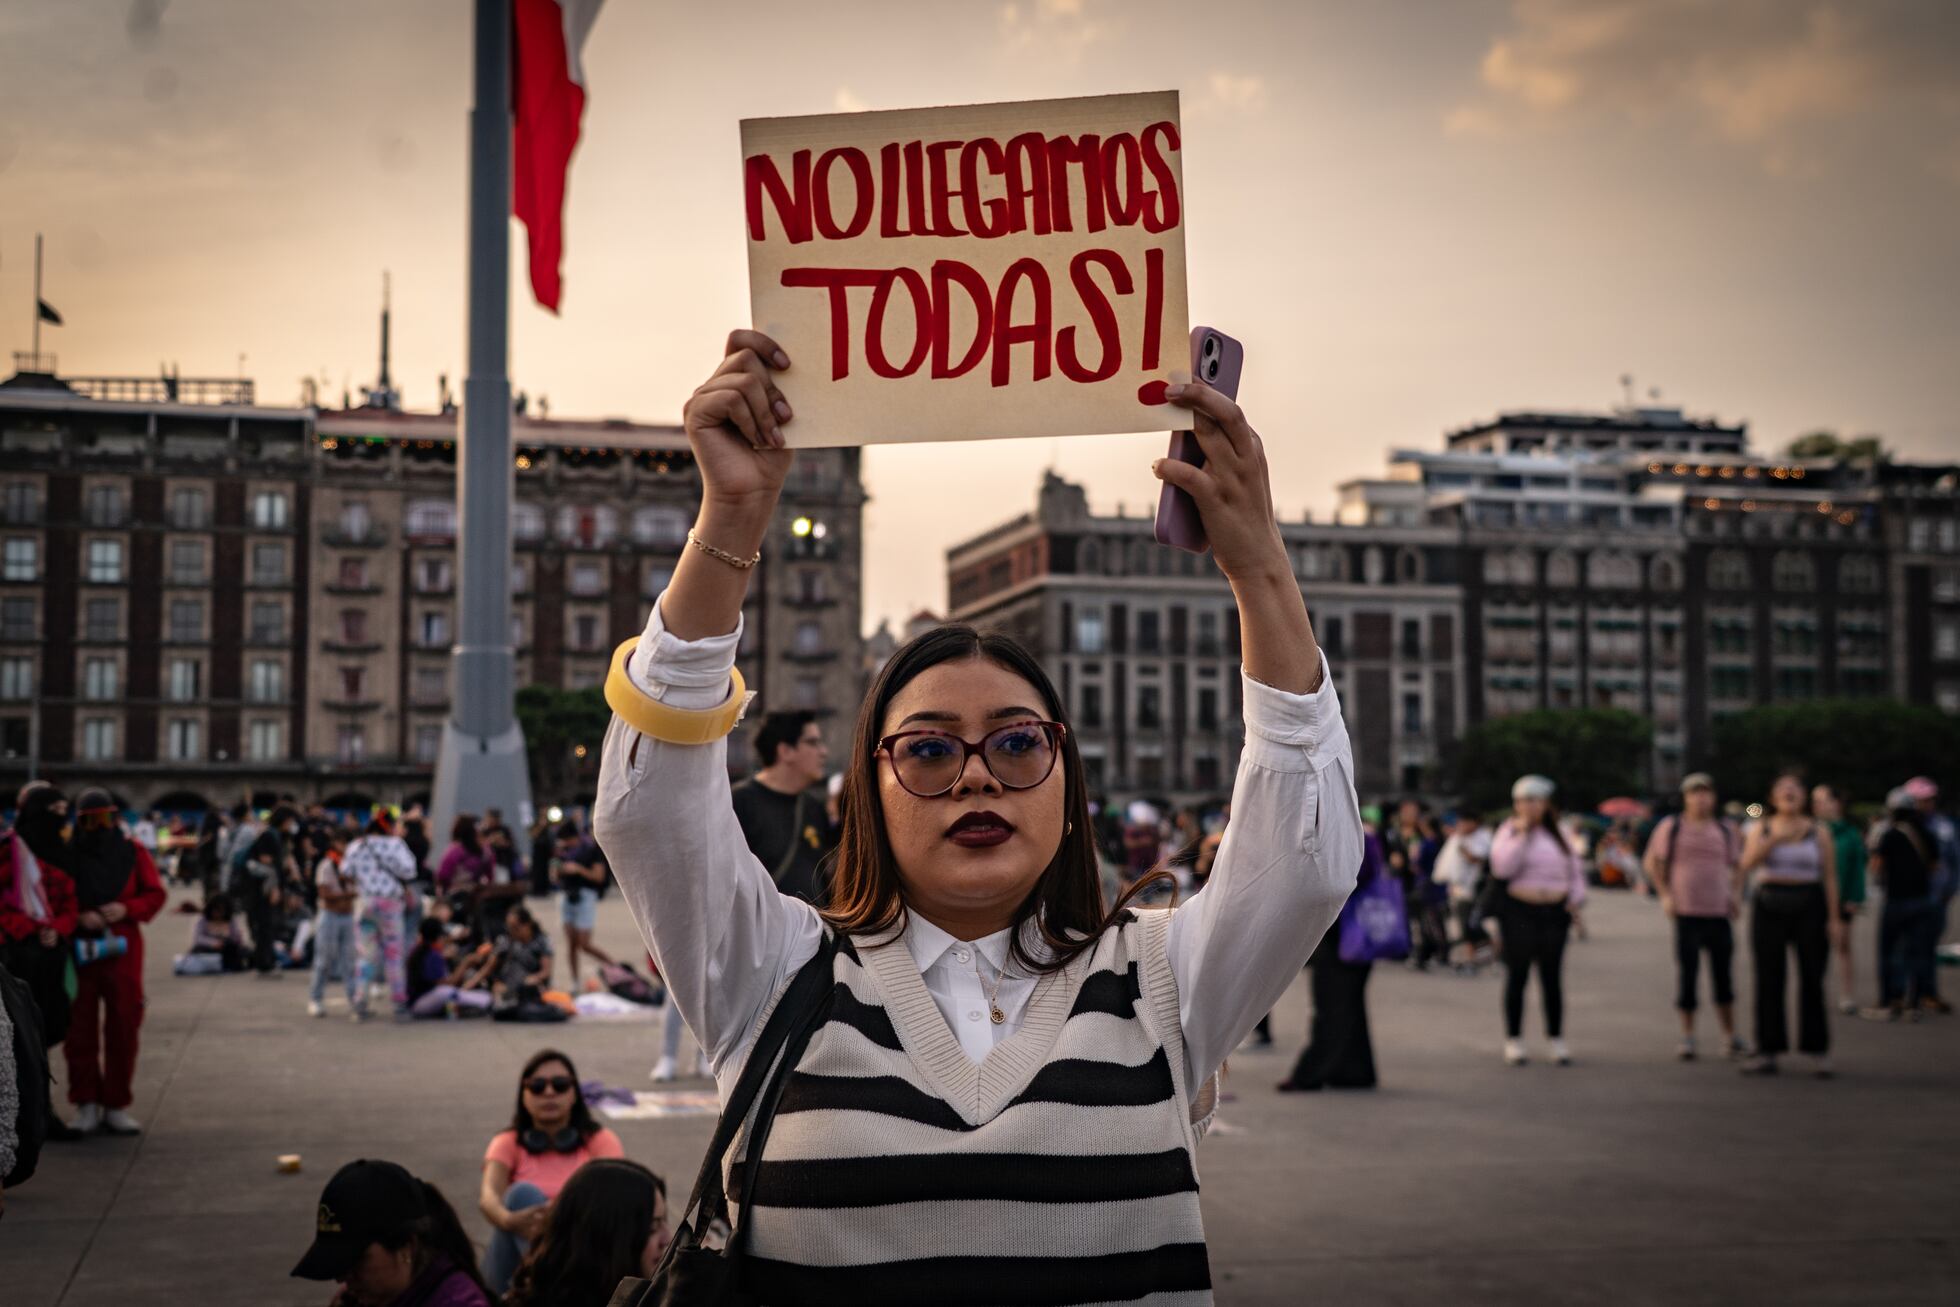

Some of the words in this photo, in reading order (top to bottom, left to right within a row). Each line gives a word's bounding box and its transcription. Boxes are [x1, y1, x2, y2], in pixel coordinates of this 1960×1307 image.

[745, 147, 875, 244] NO
[880, 121, 1181, 239] LLEGAMOS
[781, 248, 1170, 406] TODAS!
